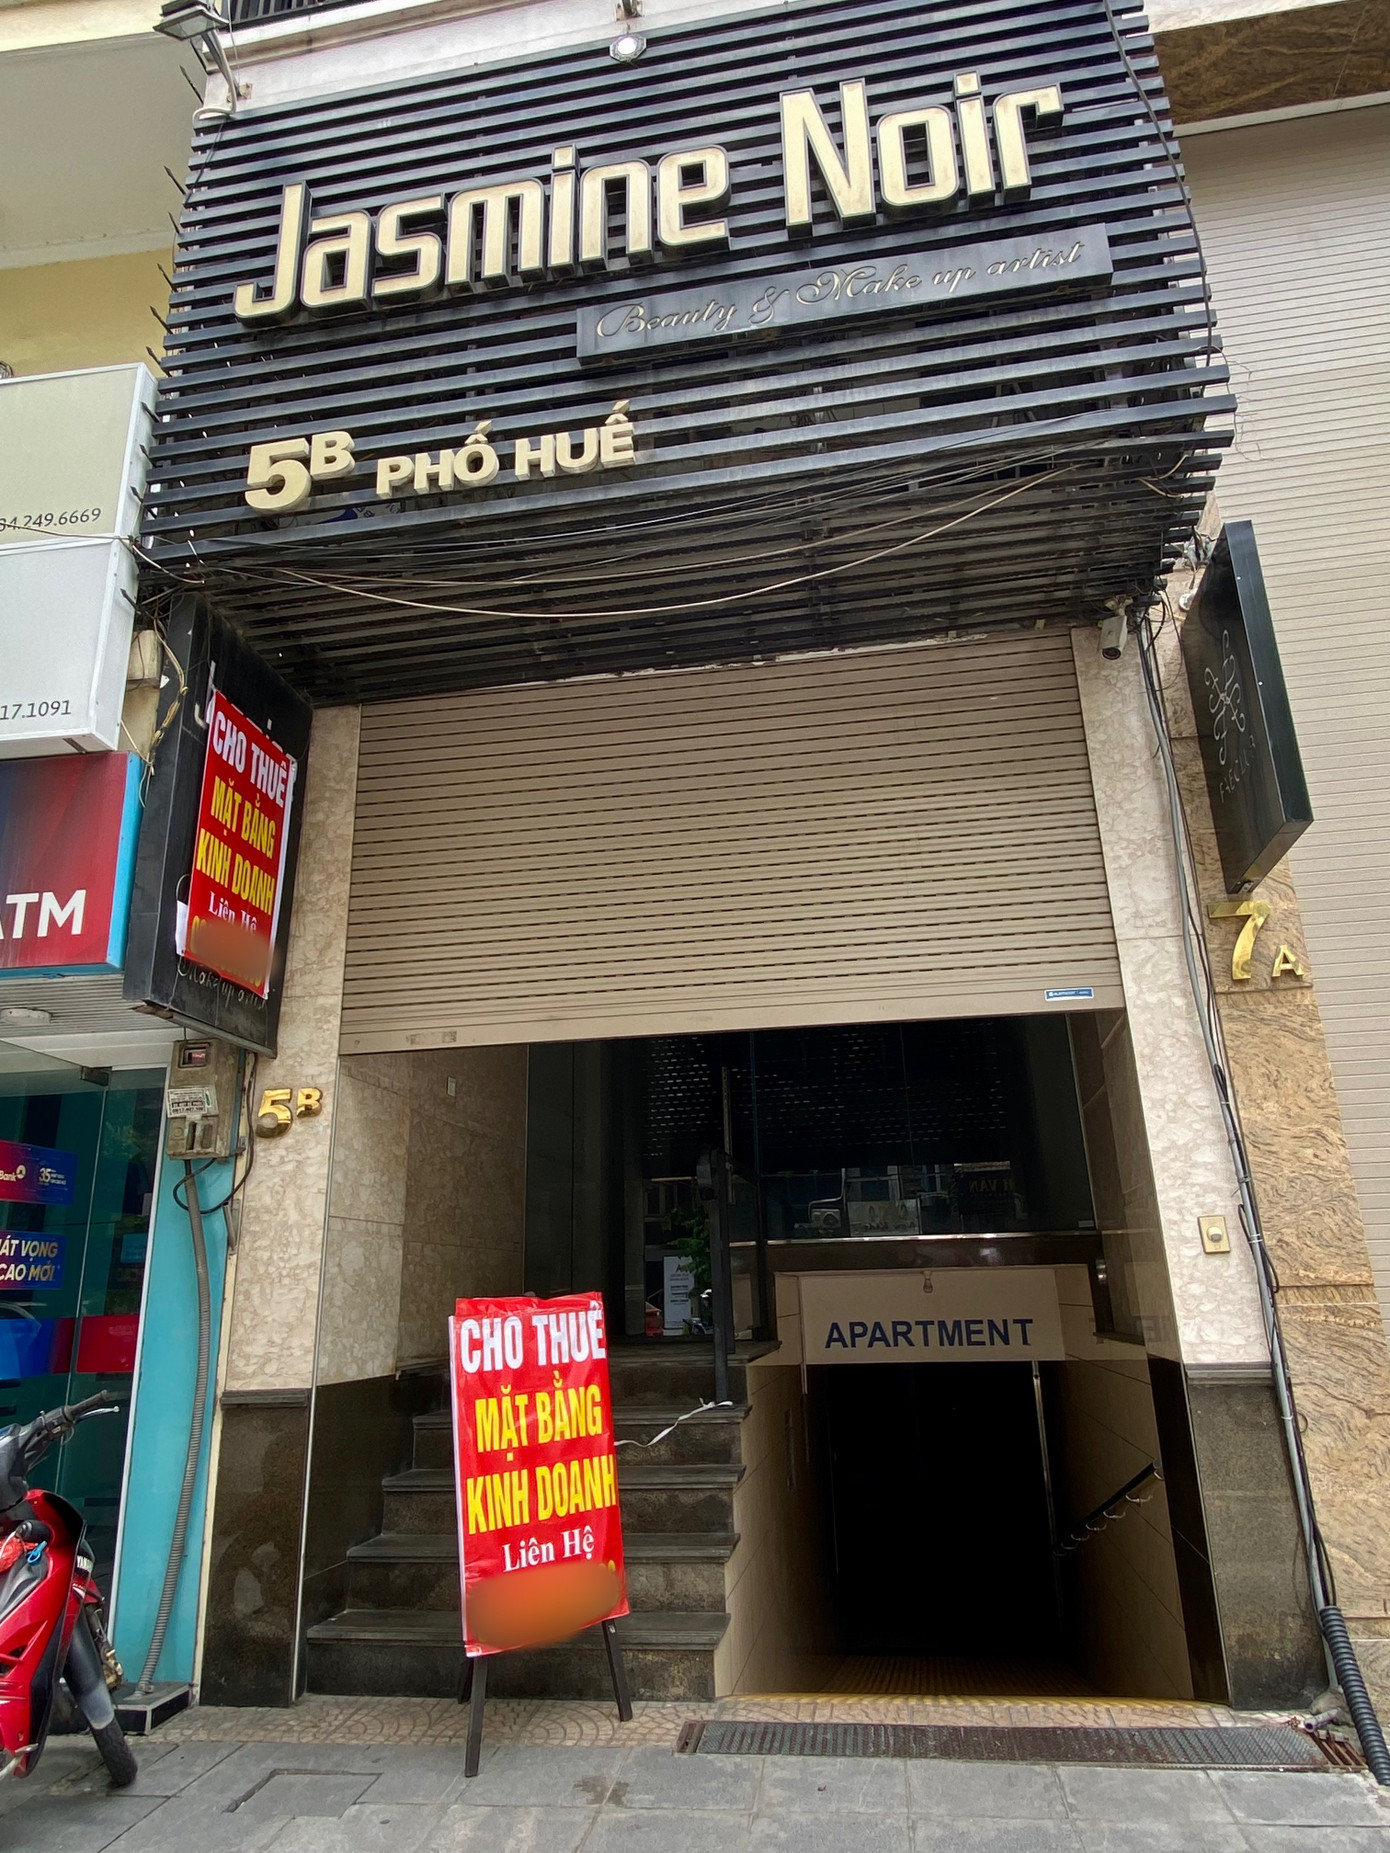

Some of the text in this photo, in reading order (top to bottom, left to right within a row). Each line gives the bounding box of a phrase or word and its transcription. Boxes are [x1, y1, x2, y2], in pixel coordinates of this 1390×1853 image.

[233, 70, 1064, 324] Jasmine Noir
[595, 241, 1085, 338] Beauty & Make up artist
[244, 399, 637, 514] 5B PHỐ HUẾ
[0, 700, 71, 720] 17.1091
[212, 711, 287, 808] CHO THUÊ
[210, 775, 276, 859] MẶT BẰNG
[196, 828, 275, 915] KINH DOANH
[208, 891, 235, 924] Liên
[0, 889, 87, 940] TM
[256, 1087, 323, 1138] 5B
[0, 1235, 59, 1262] ÁT VỌNG
[28, 1261, 56, 1281] MỚI
[460, 1300, 607, 1374] CHO THUÊ
[824, 1318, 1034, 1349] APARTMENT
[475, 1370, 603, 1462] MẶT BẰNG
[466, 1454, 617, 1536] KINH DOANH
[502, 1525, 595, 1573] Liên Hệ
